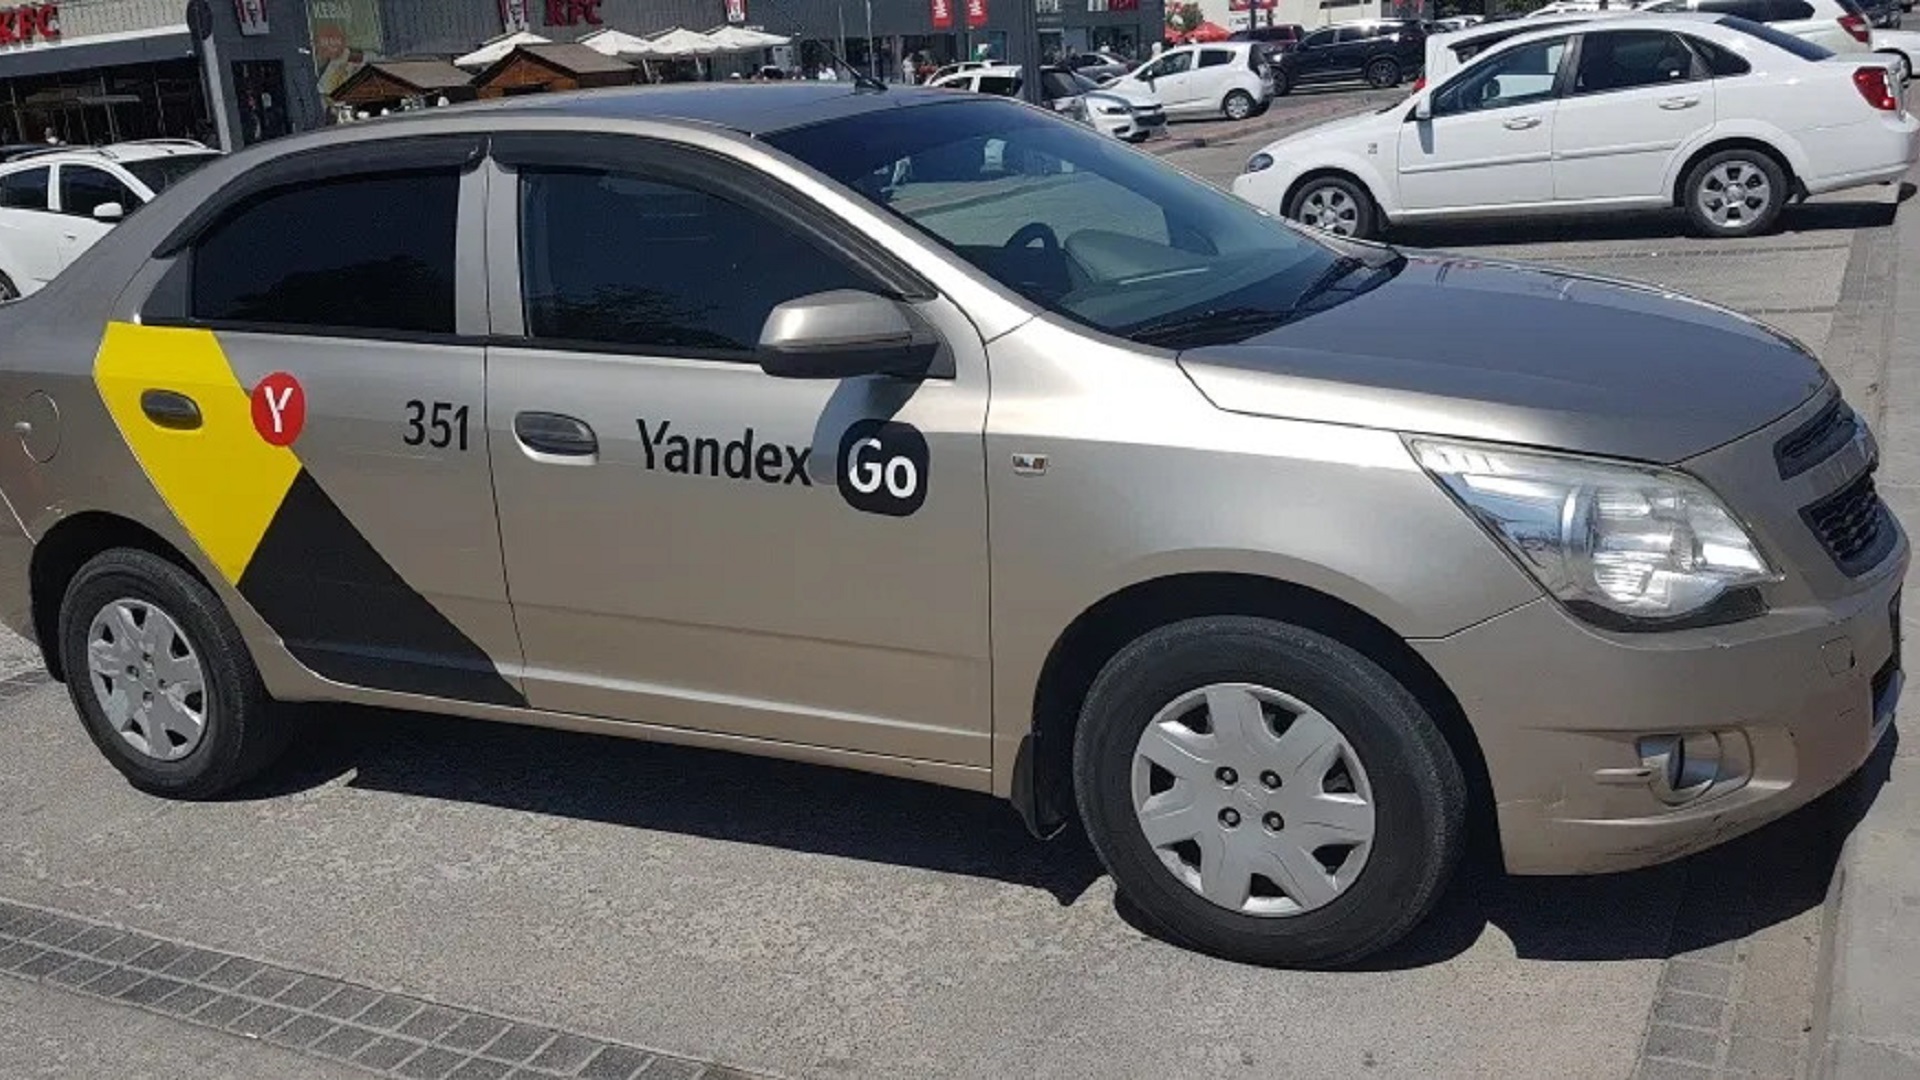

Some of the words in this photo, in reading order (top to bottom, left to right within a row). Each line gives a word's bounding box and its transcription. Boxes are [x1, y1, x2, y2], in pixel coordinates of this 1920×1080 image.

[0, 4, 58, 45] KFC
[544, 0, 603, 26] KFC
[263, 385, 294, 433] Y
[403, 399, 468, 451] 351
[637, 418, 813, 486] Yandex
[848, 437, 918, 499] Go
